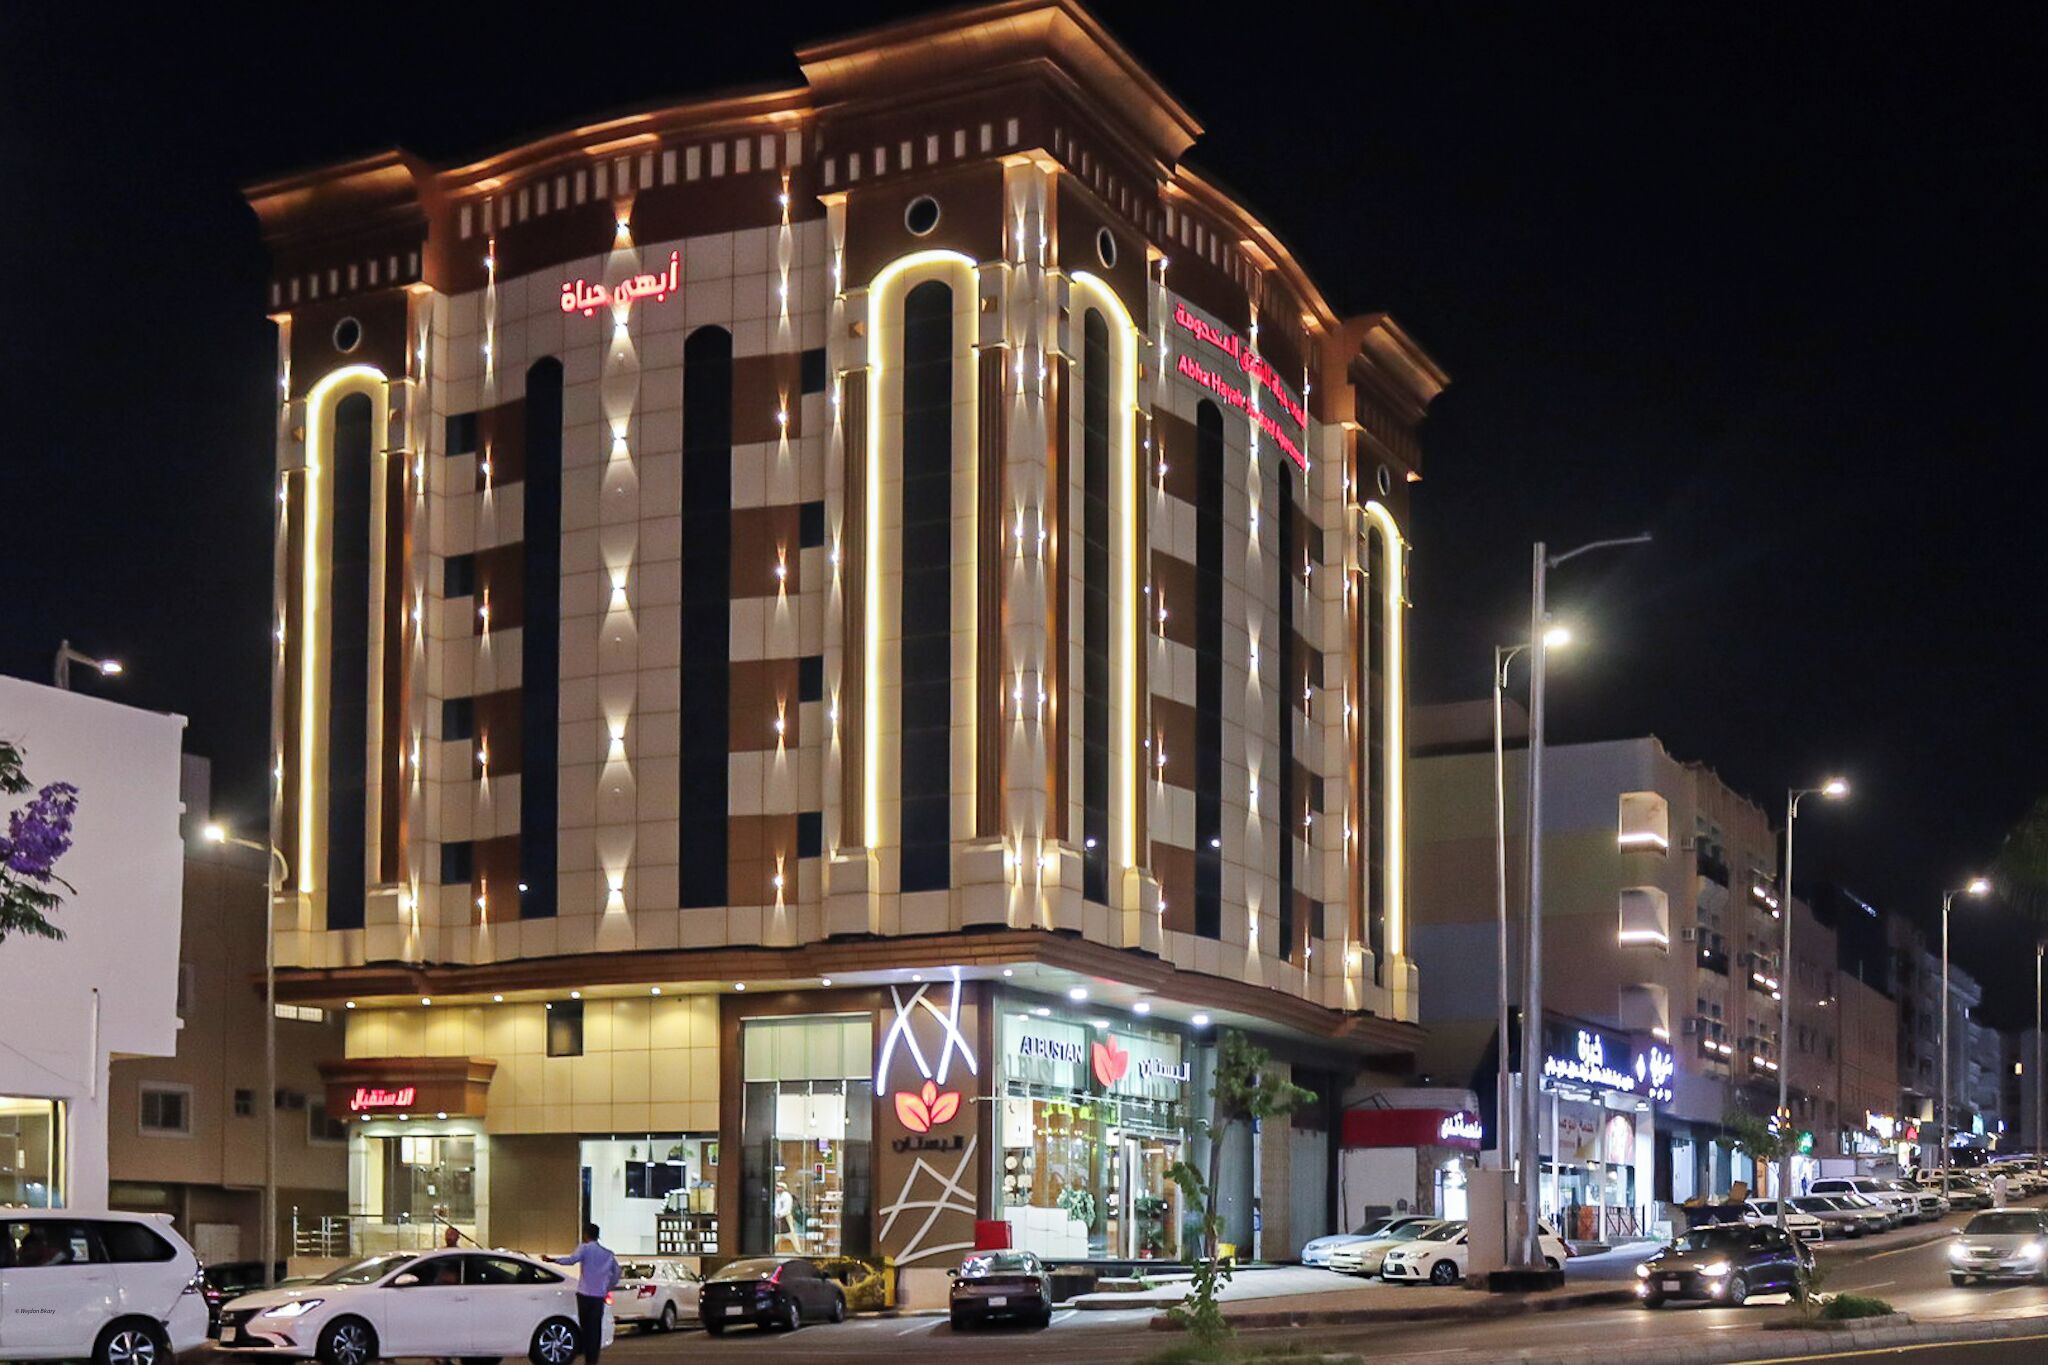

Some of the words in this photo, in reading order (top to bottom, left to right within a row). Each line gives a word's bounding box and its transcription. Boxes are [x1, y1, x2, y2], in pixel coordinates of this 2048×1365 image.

[613, 250, 680, 304] أبهى
[560, 278, 611, 317] حياة
[1174, 303, 1239, 359] المخدومة
[1177, 354, 1211, 387] Abha
[1020, 1035, 1084, 1065] ALBUSTAN
[1138, 1056, 1191, 1085] البستان
[350, 1087, 416, 1111] الاستقبال
[891, 1135, 965, 1153] البستان
